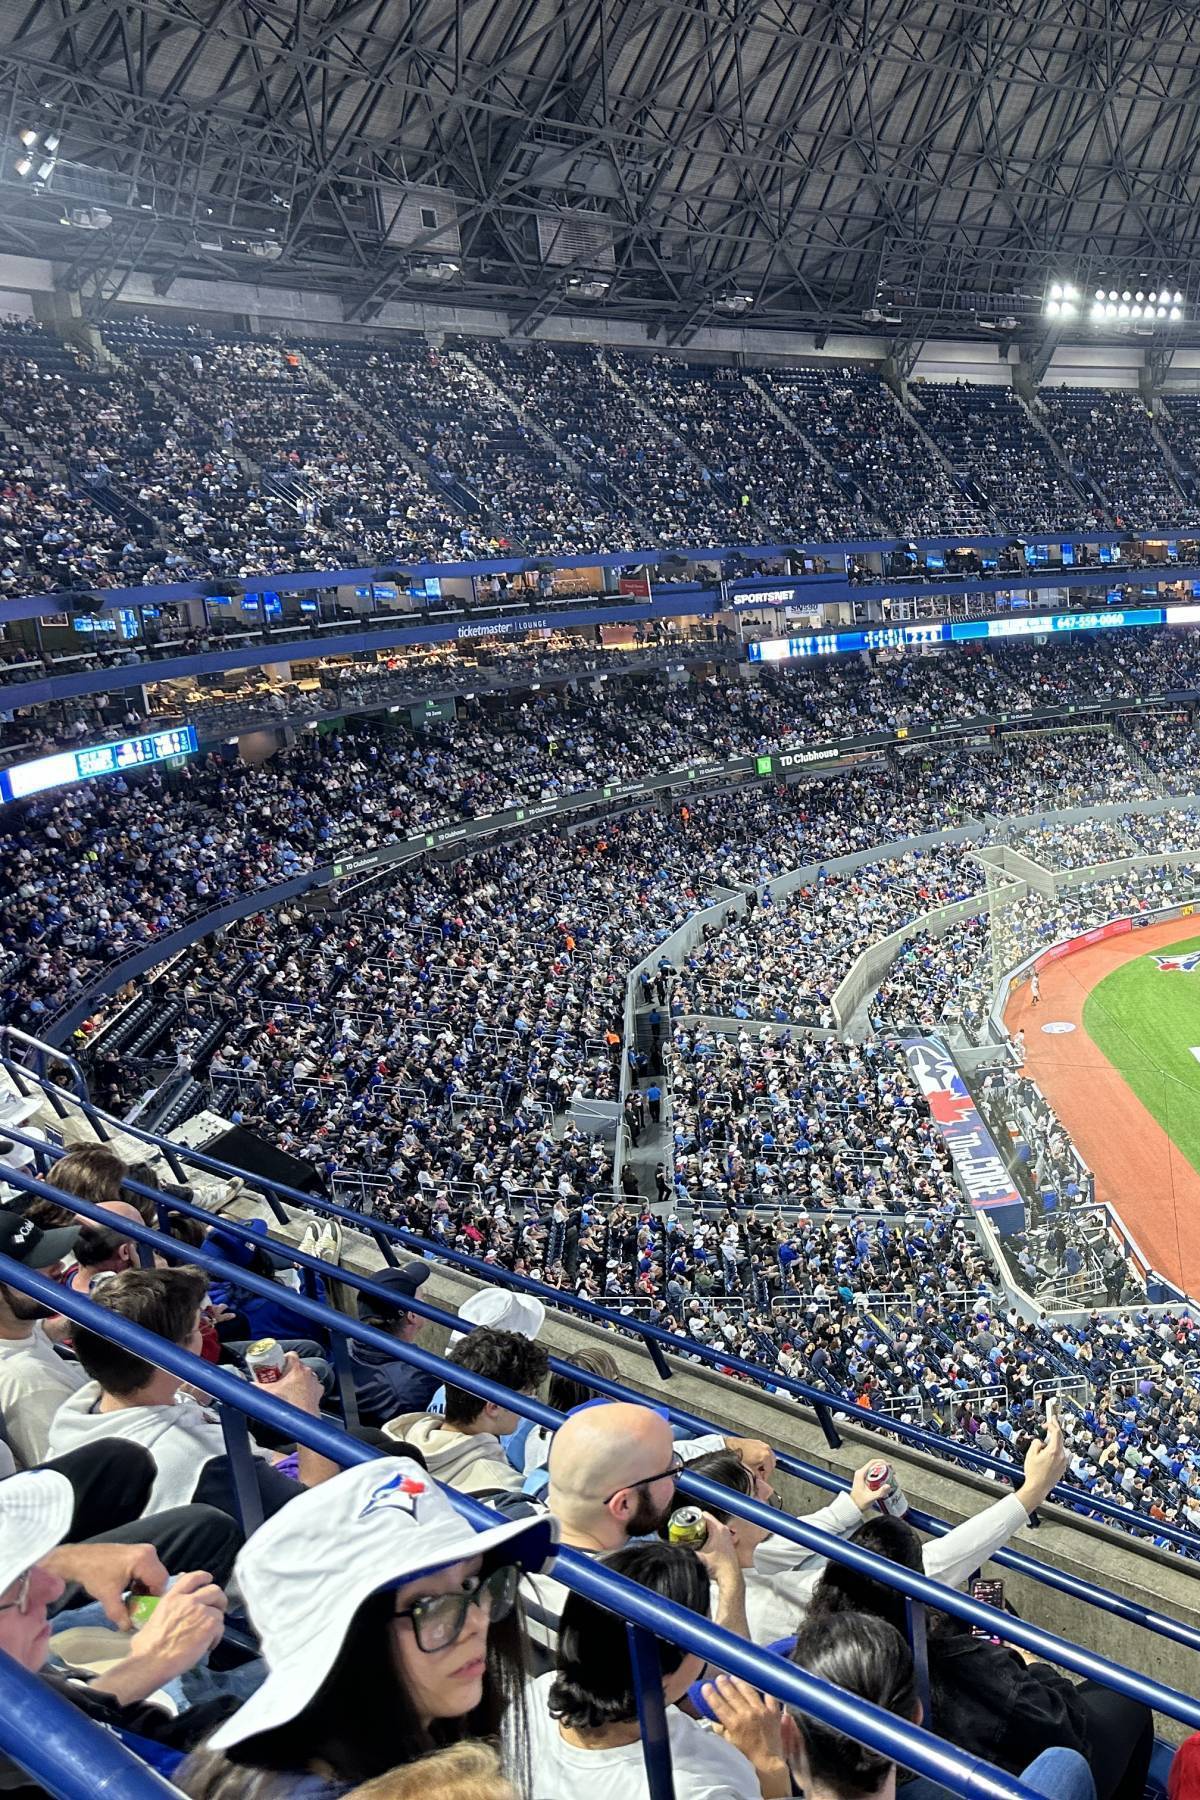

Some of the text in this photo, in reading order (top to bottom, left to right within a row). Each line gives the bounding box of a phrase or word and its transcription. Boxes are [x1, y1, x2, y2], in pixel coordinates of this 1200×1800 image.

[733, 589, 795, 605] SPORTSNET
[457, 619, 547, 638] ticketmaster LOUNGE
[780, 748, 839, 767] TD Clubhouse
[345, 856, 378, 871] TD Clubhouse
[957, 1156, 1017, 1199] CORE
